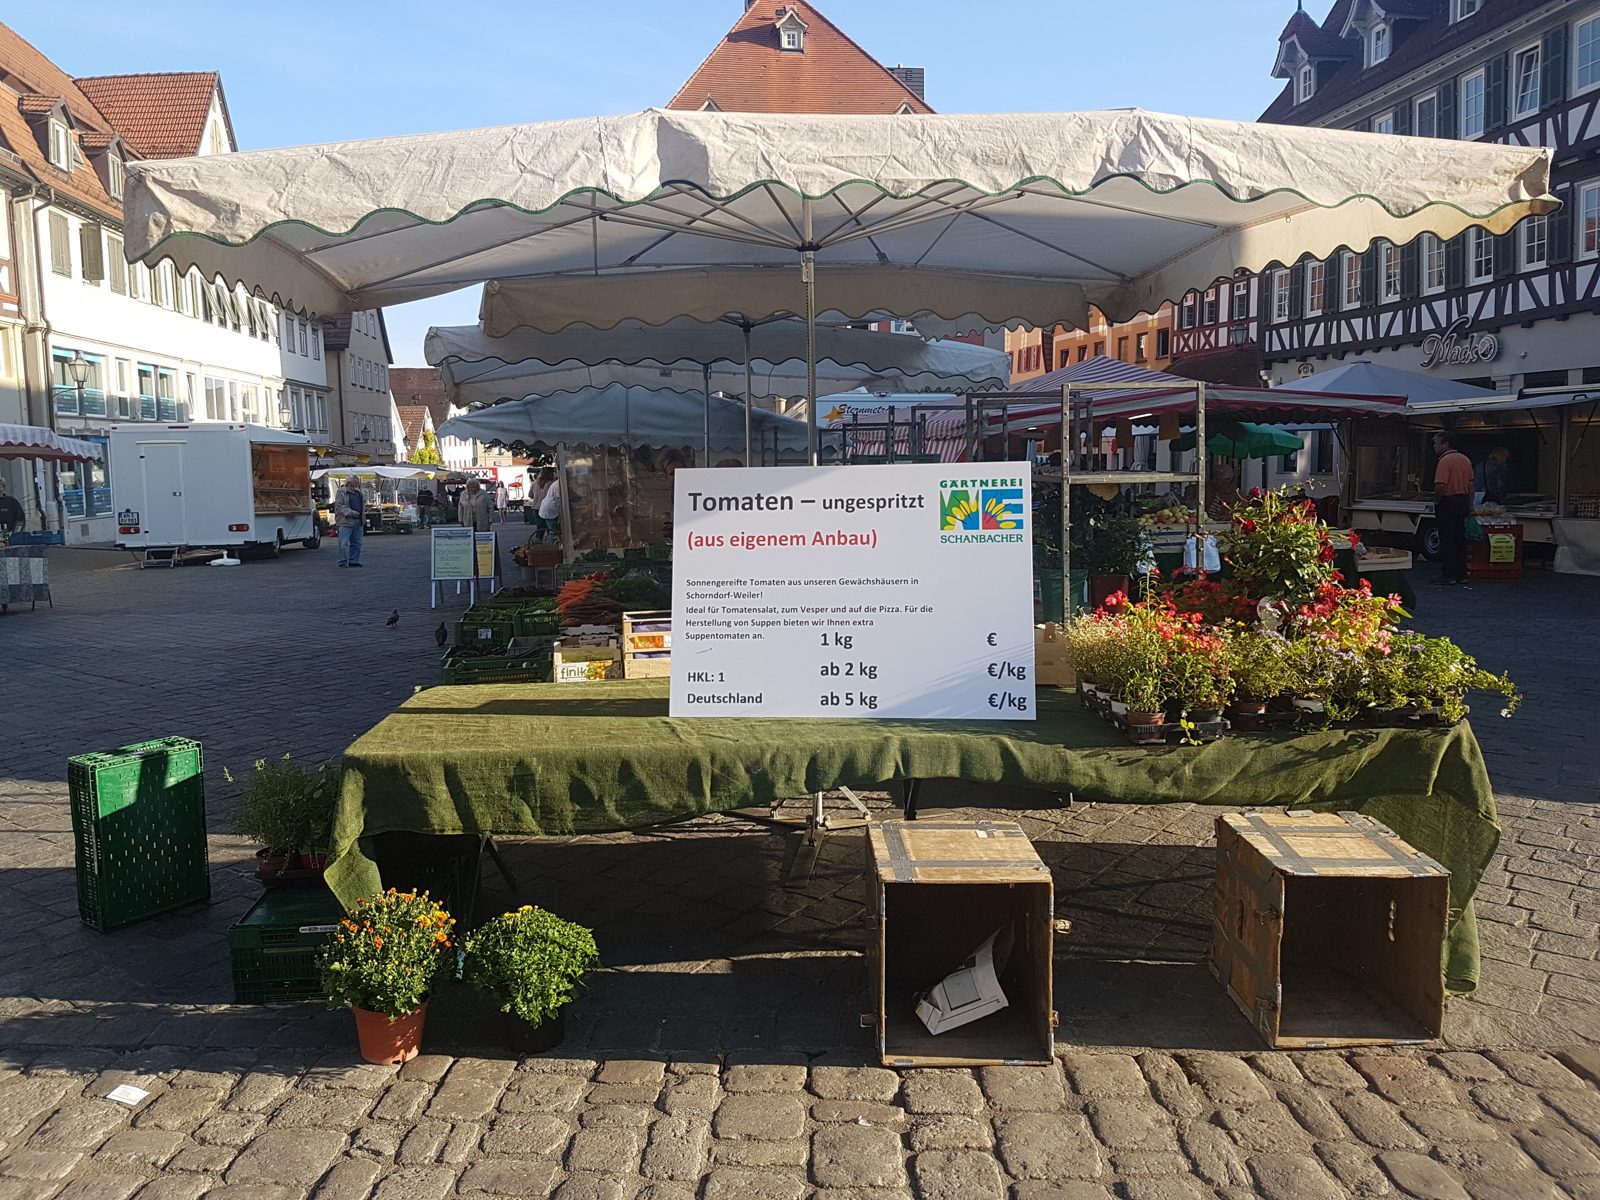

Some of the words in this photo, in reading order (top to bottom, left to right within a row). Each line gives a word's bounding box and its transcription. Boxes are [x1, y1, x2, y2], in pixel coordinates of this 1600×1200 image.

[940, 477, 1023, 488] GÄRTNEREI
[687, 492, 794, 512] Tomaten
[822, 493, 925, 514] ungespritzt
[687, 530, 725, 551] (aus
[729, 533, 806, 551] eigenem
[811, 529, 878, 549] Anbau)
[940, 533, 1023, 544] SCHANBACHER
[686, 578, 748, 588] Sonnengereifte
[749, 578, 786, 587] Tomaten
[838, 577, 909, 586] Gewächshäusern
[910, 577, 919, 586] in
[686, 591, 763, 600] Schorndorf-Weiler!
[685, 605, 706, 614] Ideal
[707, 605, 720, 614] für
[721, 605, 779, 615] Tomatensalat,
[800, 605, 829, 615] Vesper
[830, 605, 847, 614] und
[848, 604, 863, 613] auf
[863, 605, 877, 614] die
[878, 605, 903, 614] Pizza.
[904, 604, 919, 613] Für
[920, 604, 934, 613] die
[685, 618, 732, 629] Herstellung
[750, 618, 782, 629] Suppen
[783, 618, 810, 627] bieten
[811, 618, 826, 627] wir
[826, 618, 851, 627] Ihnen
[852, 618, 875, 627] extra
[685, 631, 751, 642] Suppentomaten
[820, 632, 830, 647] 1
[834, 632, 853, 650] kg
[986, 632, 998, 647] €
[820, 661, 841, 677] ab
[844, 662, 855, 677] 2
[859, 661, 878, 680] kg
[987, 661, 1027, 681] €/kg
[687, 671, 715, 683] HKL:
[718, 671, 726, 683] 1
[687, 692, 763, 704] Deutschland
[820, 691, 841, 707] ab
[844, 692, 855, 707] 5
[859, 691, 878, 710] kg
[987, 691, 1028, 712] €/kg
